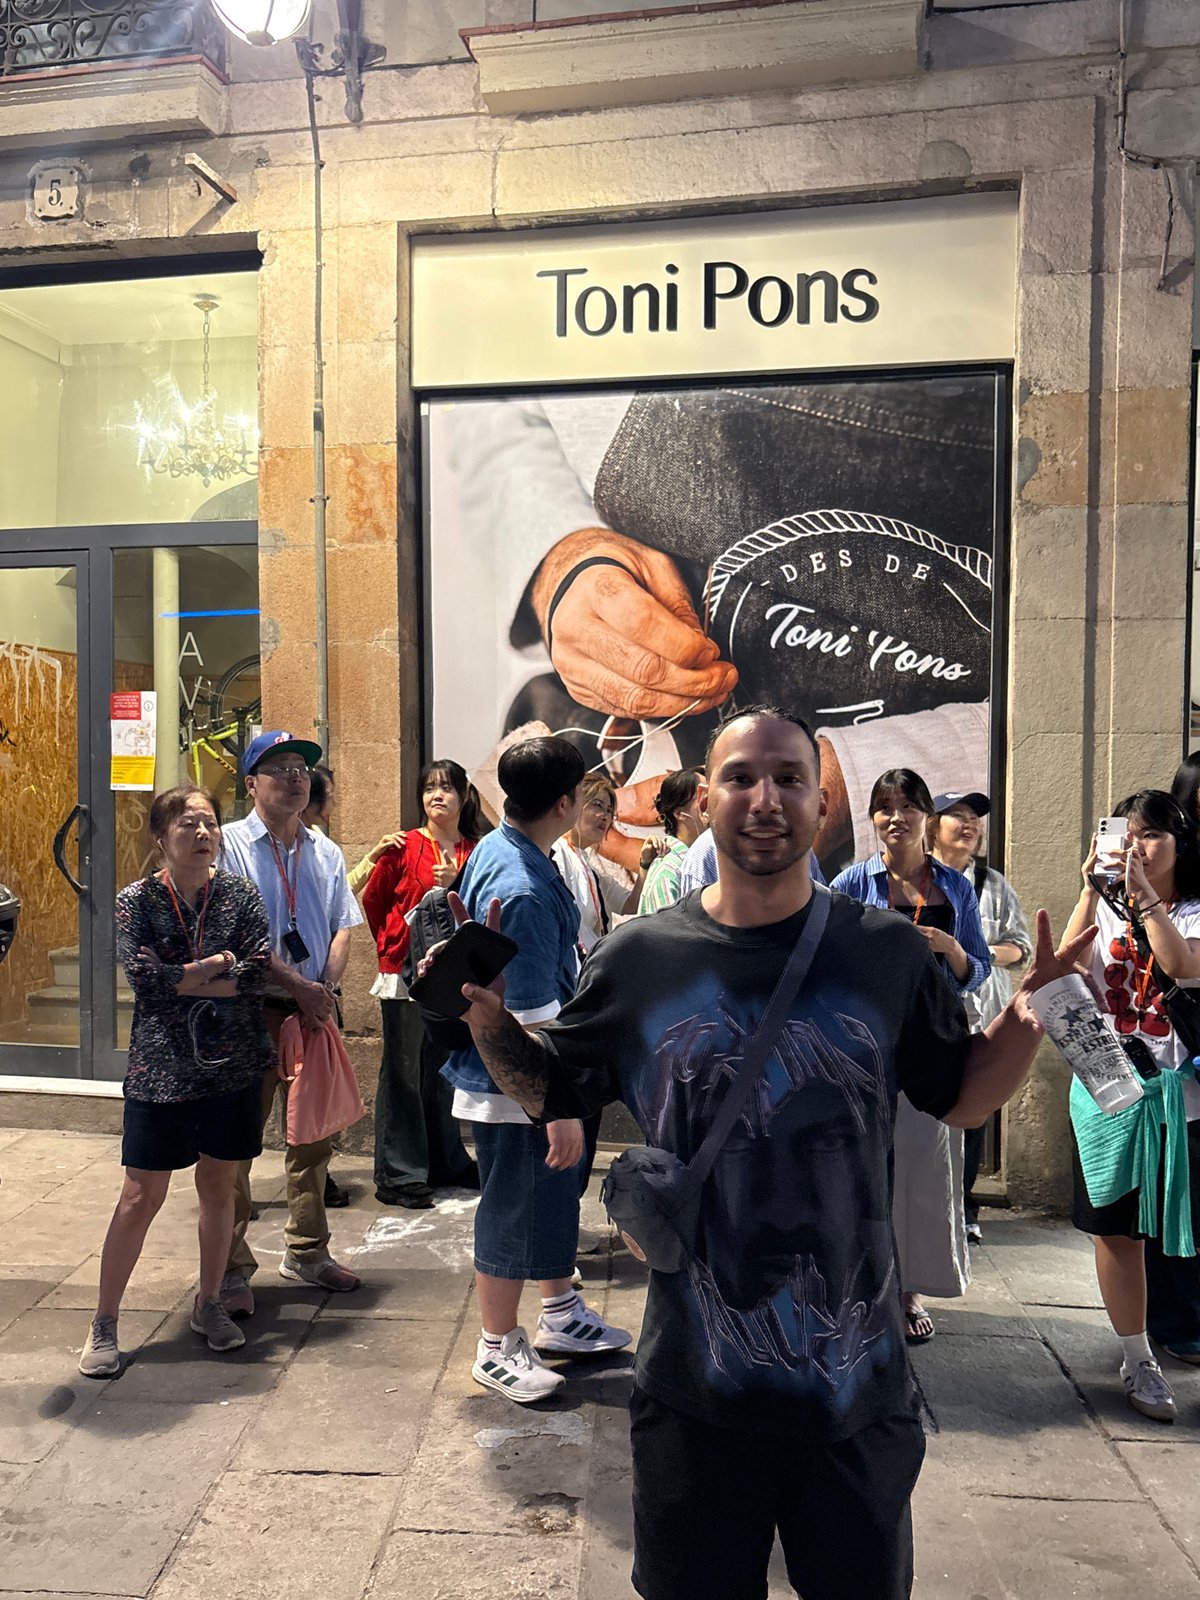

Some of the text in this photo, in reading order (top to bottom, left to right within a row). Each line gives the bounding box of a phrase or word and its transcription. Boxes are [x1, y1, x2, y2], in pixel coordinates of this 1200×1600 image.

[536, 261, 880, 337] Toni Pons
[779, 549, 931, 583] DES DE
[764, 603, 858, 657] Toni
